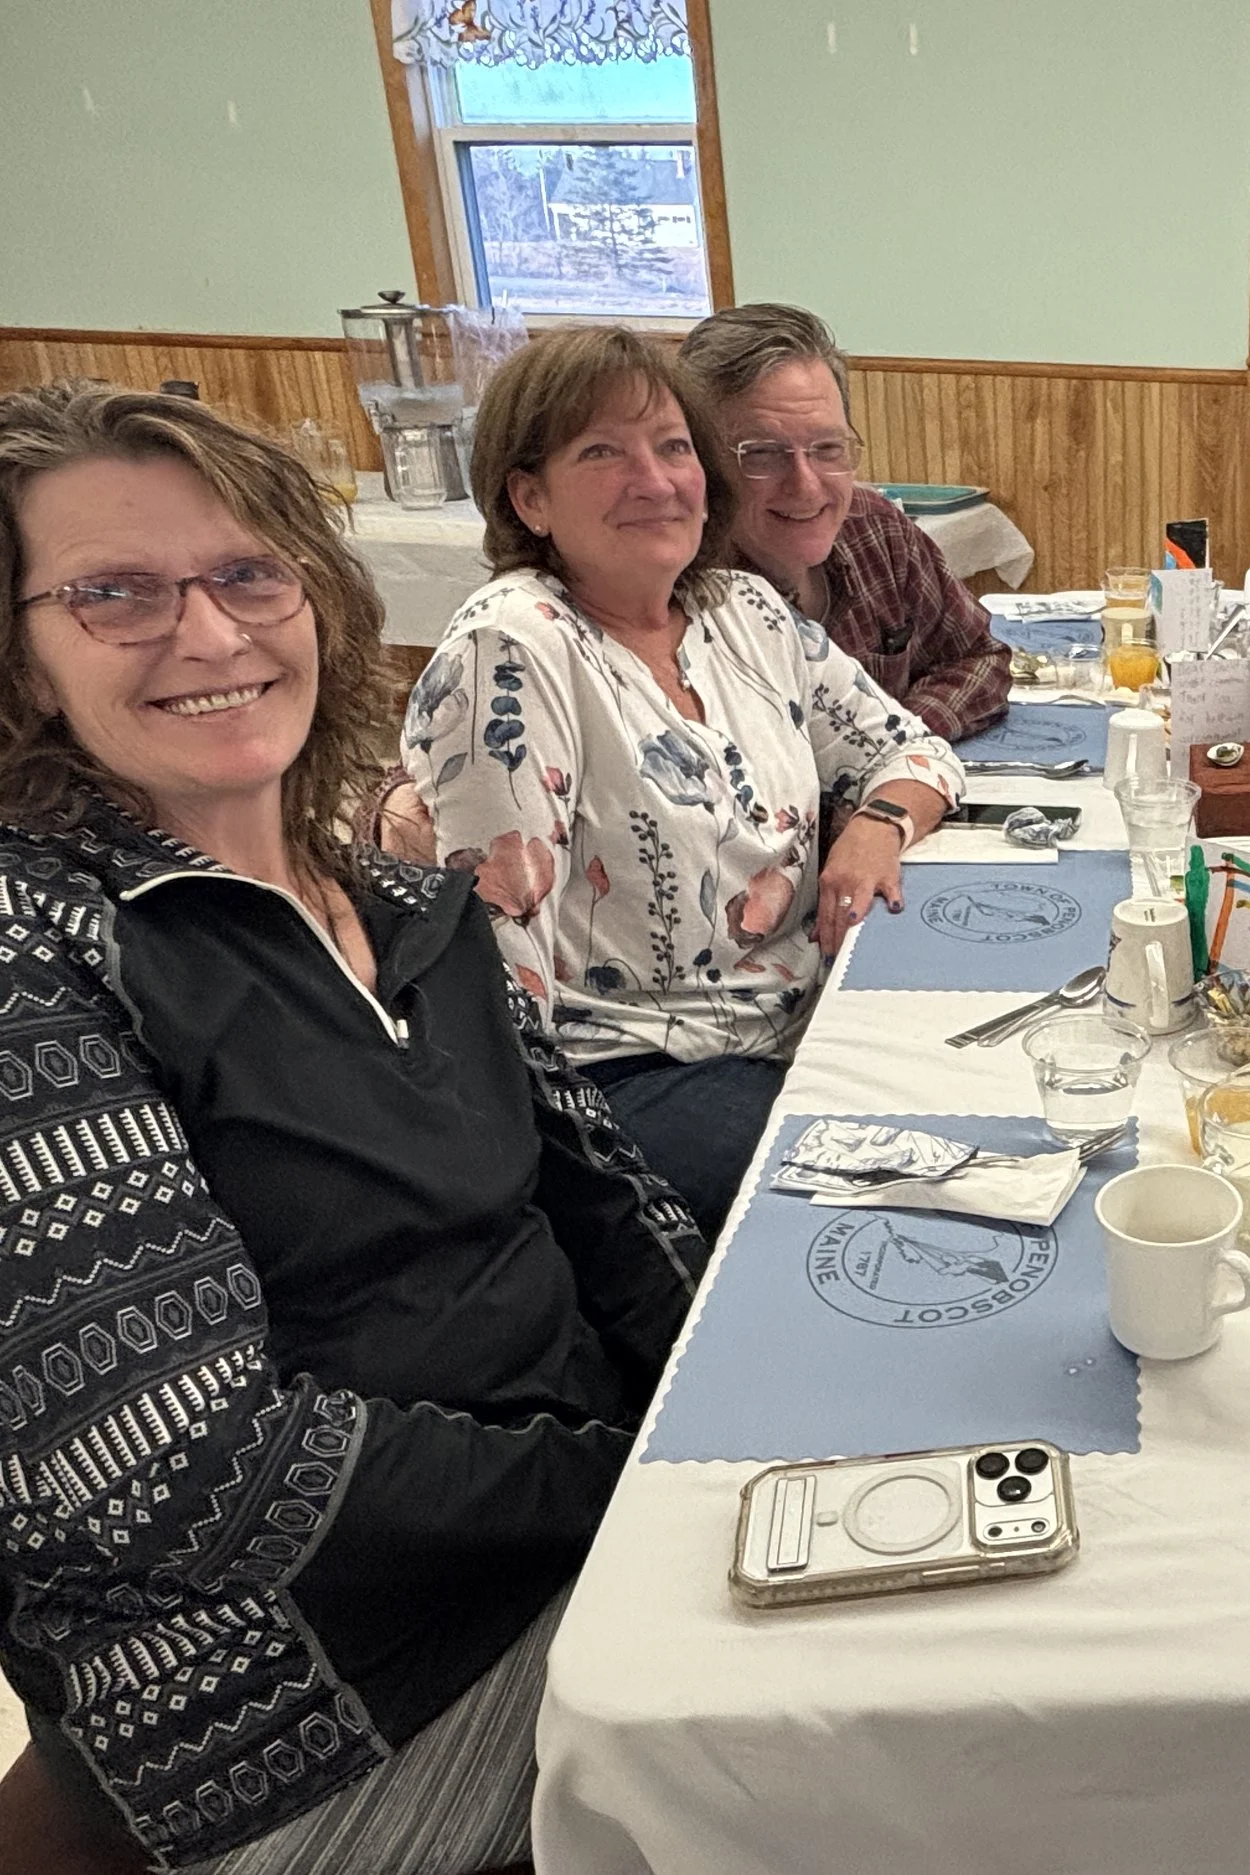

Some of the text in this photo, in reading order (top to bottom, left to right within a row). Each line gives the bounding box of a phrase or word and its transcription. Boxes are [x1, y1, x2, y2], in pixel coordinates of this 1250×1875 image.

[992, 883, 1047, 895] TOWN
[1050, 893, 1073, 905] OF
[984, 907, 1077, 943] PENOBSCOT
[814, 1222, 855, 1286] MAINE
[854, 1250, 871, 1279] 1787
[893, 1236, 1051, 1324] PENOBSCOT
